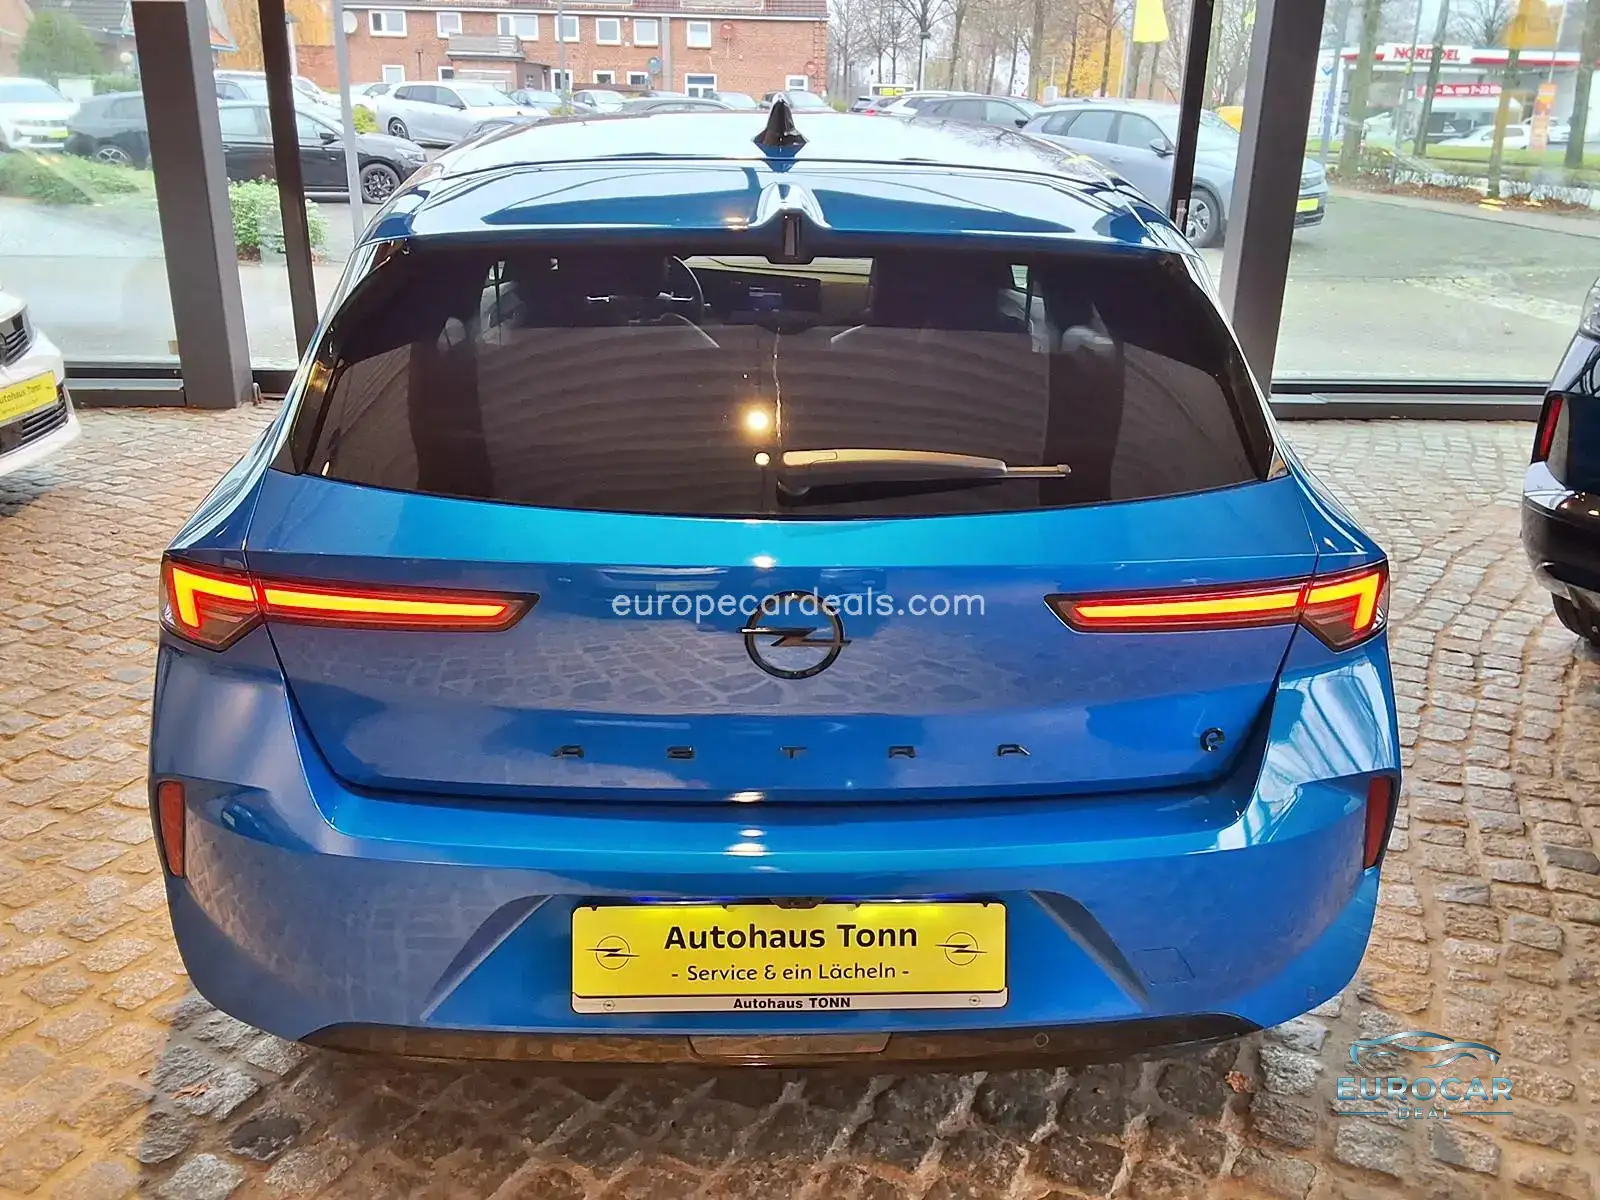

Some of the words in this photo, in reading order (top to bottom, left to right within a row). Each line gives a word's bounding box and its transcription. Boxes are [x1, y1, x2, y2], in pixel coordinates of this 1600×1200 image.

[551, 744, 1030, 759] ASTRA
[664, 924, 826, 950] Autohaus
[836, 924, 918, 948] Tonn
[687, 965, 758, 981] Service
[764, 964, 777, 980] &
[783, 963, 812, 980] ein
[819, 963, 896, 980] Lächeln
[733, 998, 804, 1009] Autohaus
[809, 997, 851, 1008] TONN
